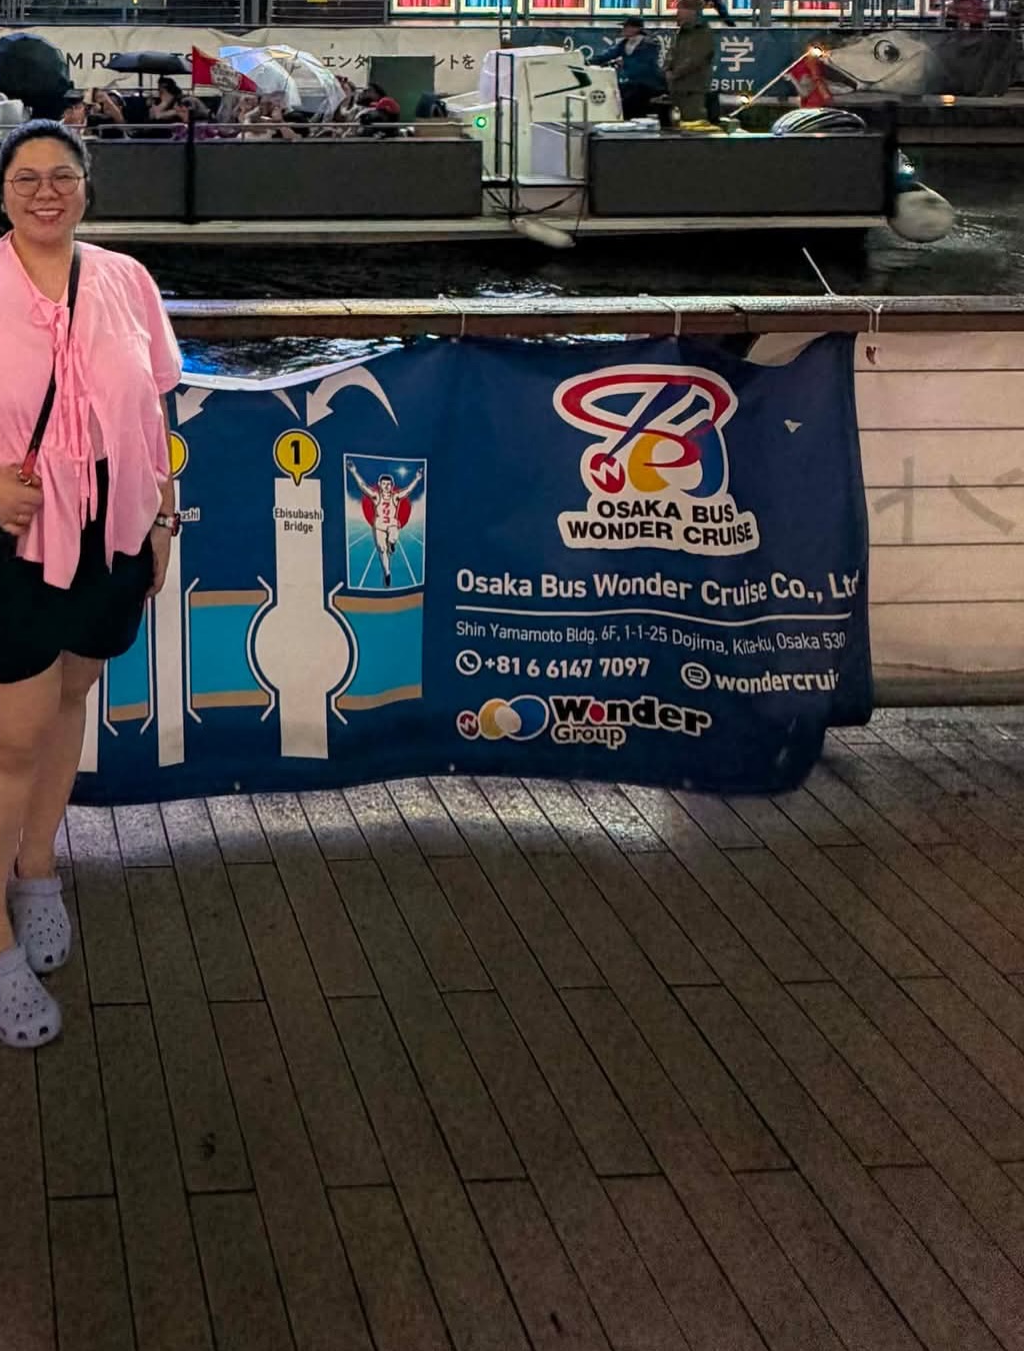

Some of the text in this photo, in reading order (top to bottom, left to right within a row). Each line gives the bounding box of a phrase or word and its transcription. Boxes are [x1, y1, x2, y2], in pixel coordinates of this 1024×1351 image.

[290, 439, 301, 465] 1
[275, 508, 323, 520] Ebisubashi
[597, 499, 735, 524] OSAKA BUS
[283, 520, 314, 533] Bridge
[567, 520, 754, 546] WONDER CRUISE
[456, 568, 533, 597] Osaka
[541, 574, 588, 598] Bus
[592, 572, 693, 600] Wonder
[700, 579, 768, 606] Cruise
[771, 572, 824, 605] Co.,
[456, 620, 487, 638] Shin
[490, 623, 564, 643] Yamamoto
[566, 627, 599, 645] Bldg.
[625, 624, 668, 643] 1-1-25
[672, 628, 729, 655] Dojima,
[732, 635, 776, 656] Kita-ku,
[776, 632, 821, 650] Osaka
[484, 654, 651, 678] +81 6 6147 7097
[714, 668, 840, 694] wondercrui
[550, 696, 709, 734] Wonder
[554, 726, 624, 748] Group
